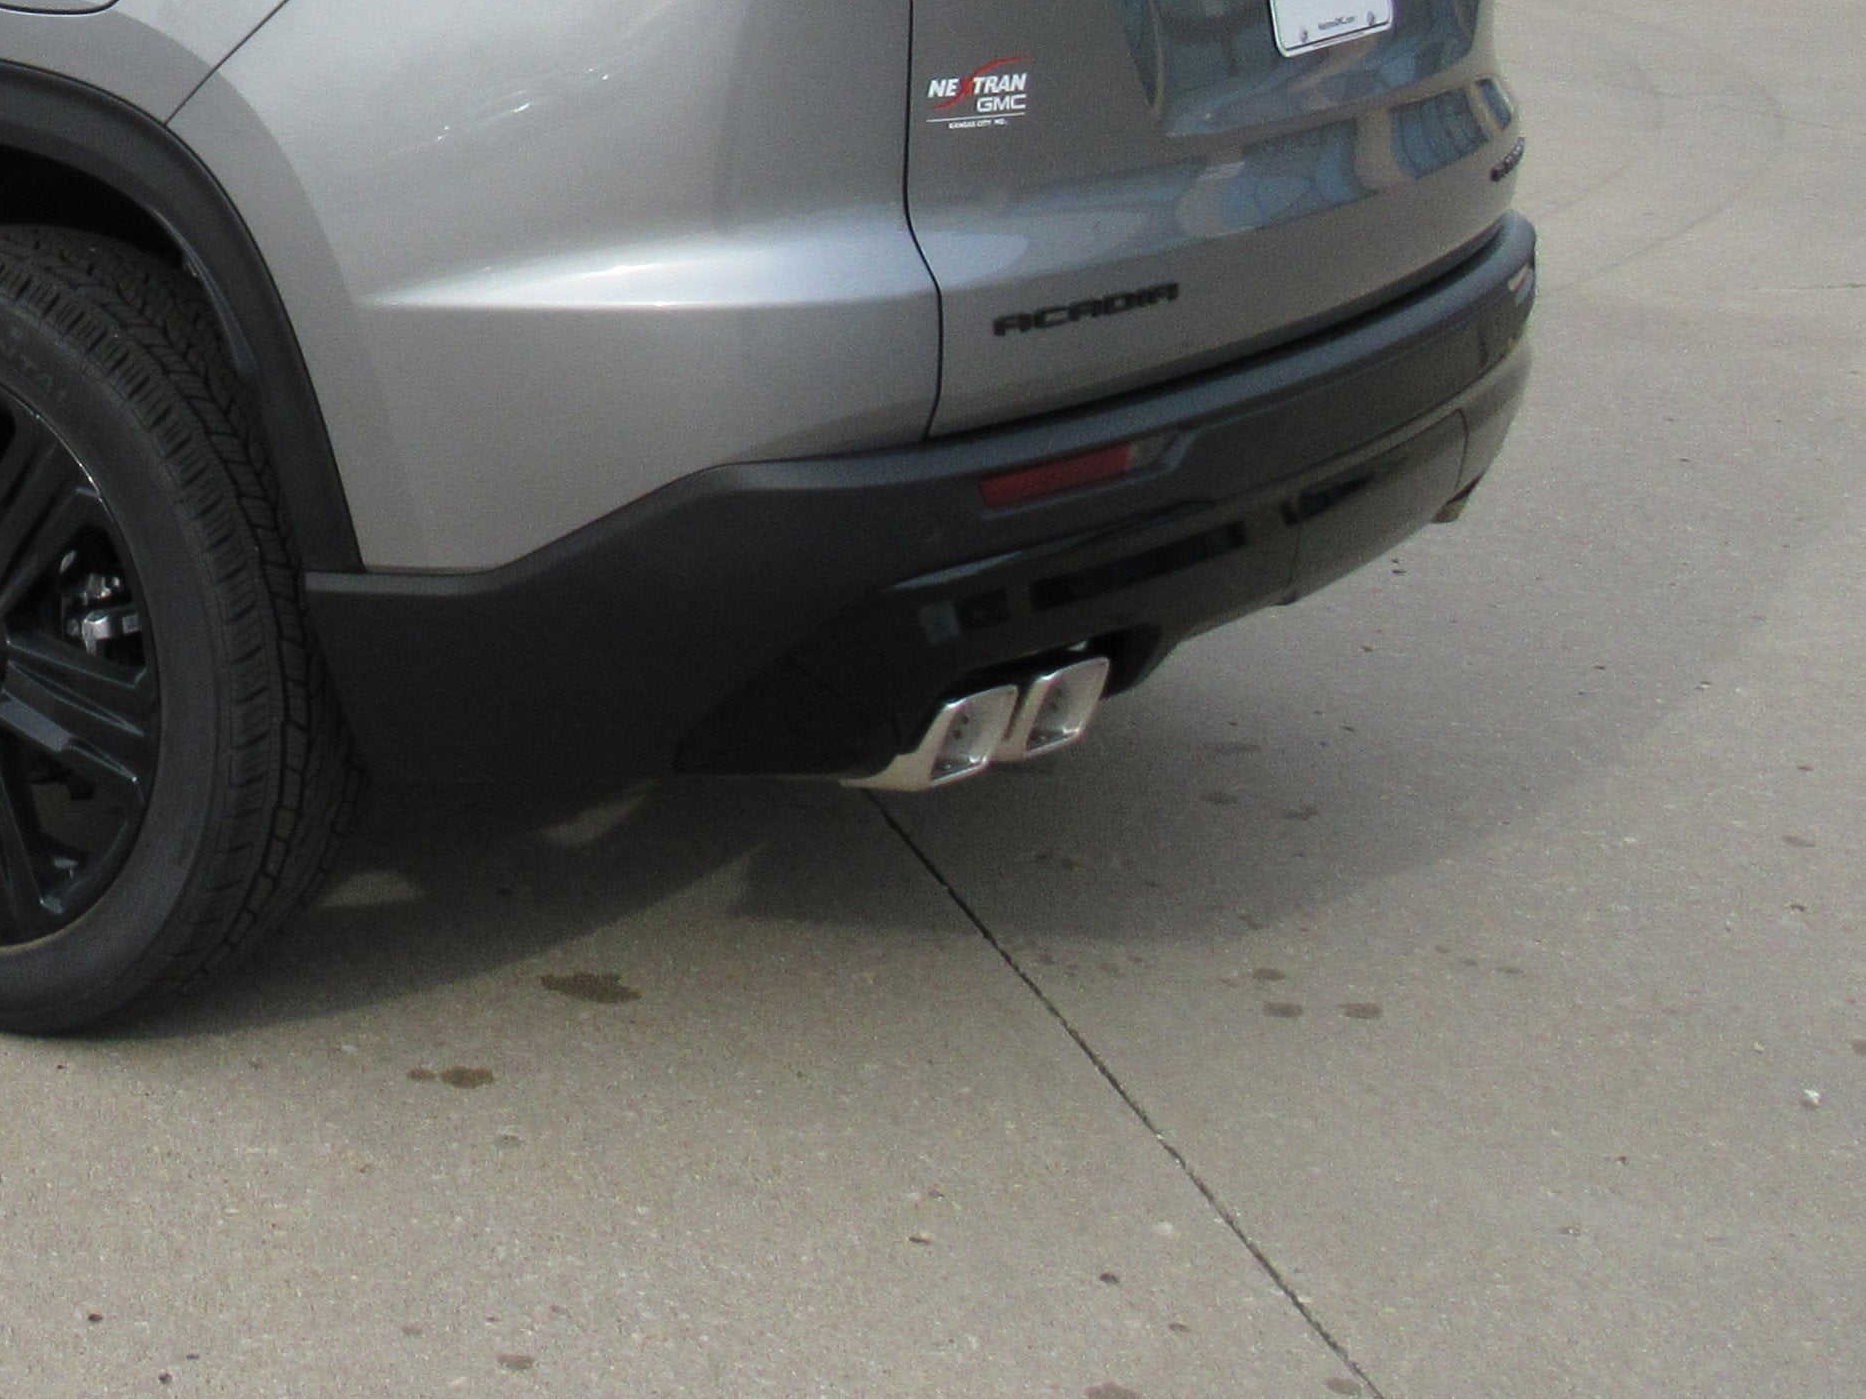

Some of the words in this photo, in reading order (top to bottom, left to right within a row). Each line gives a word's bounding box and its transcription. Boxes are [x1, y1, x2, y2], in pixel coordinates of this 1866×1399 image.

[926, 72, 1028, 99] NEXTRAN
[976, 93, 1027, 113] GMC
[991, 282, 1180, 337] ACADIA
